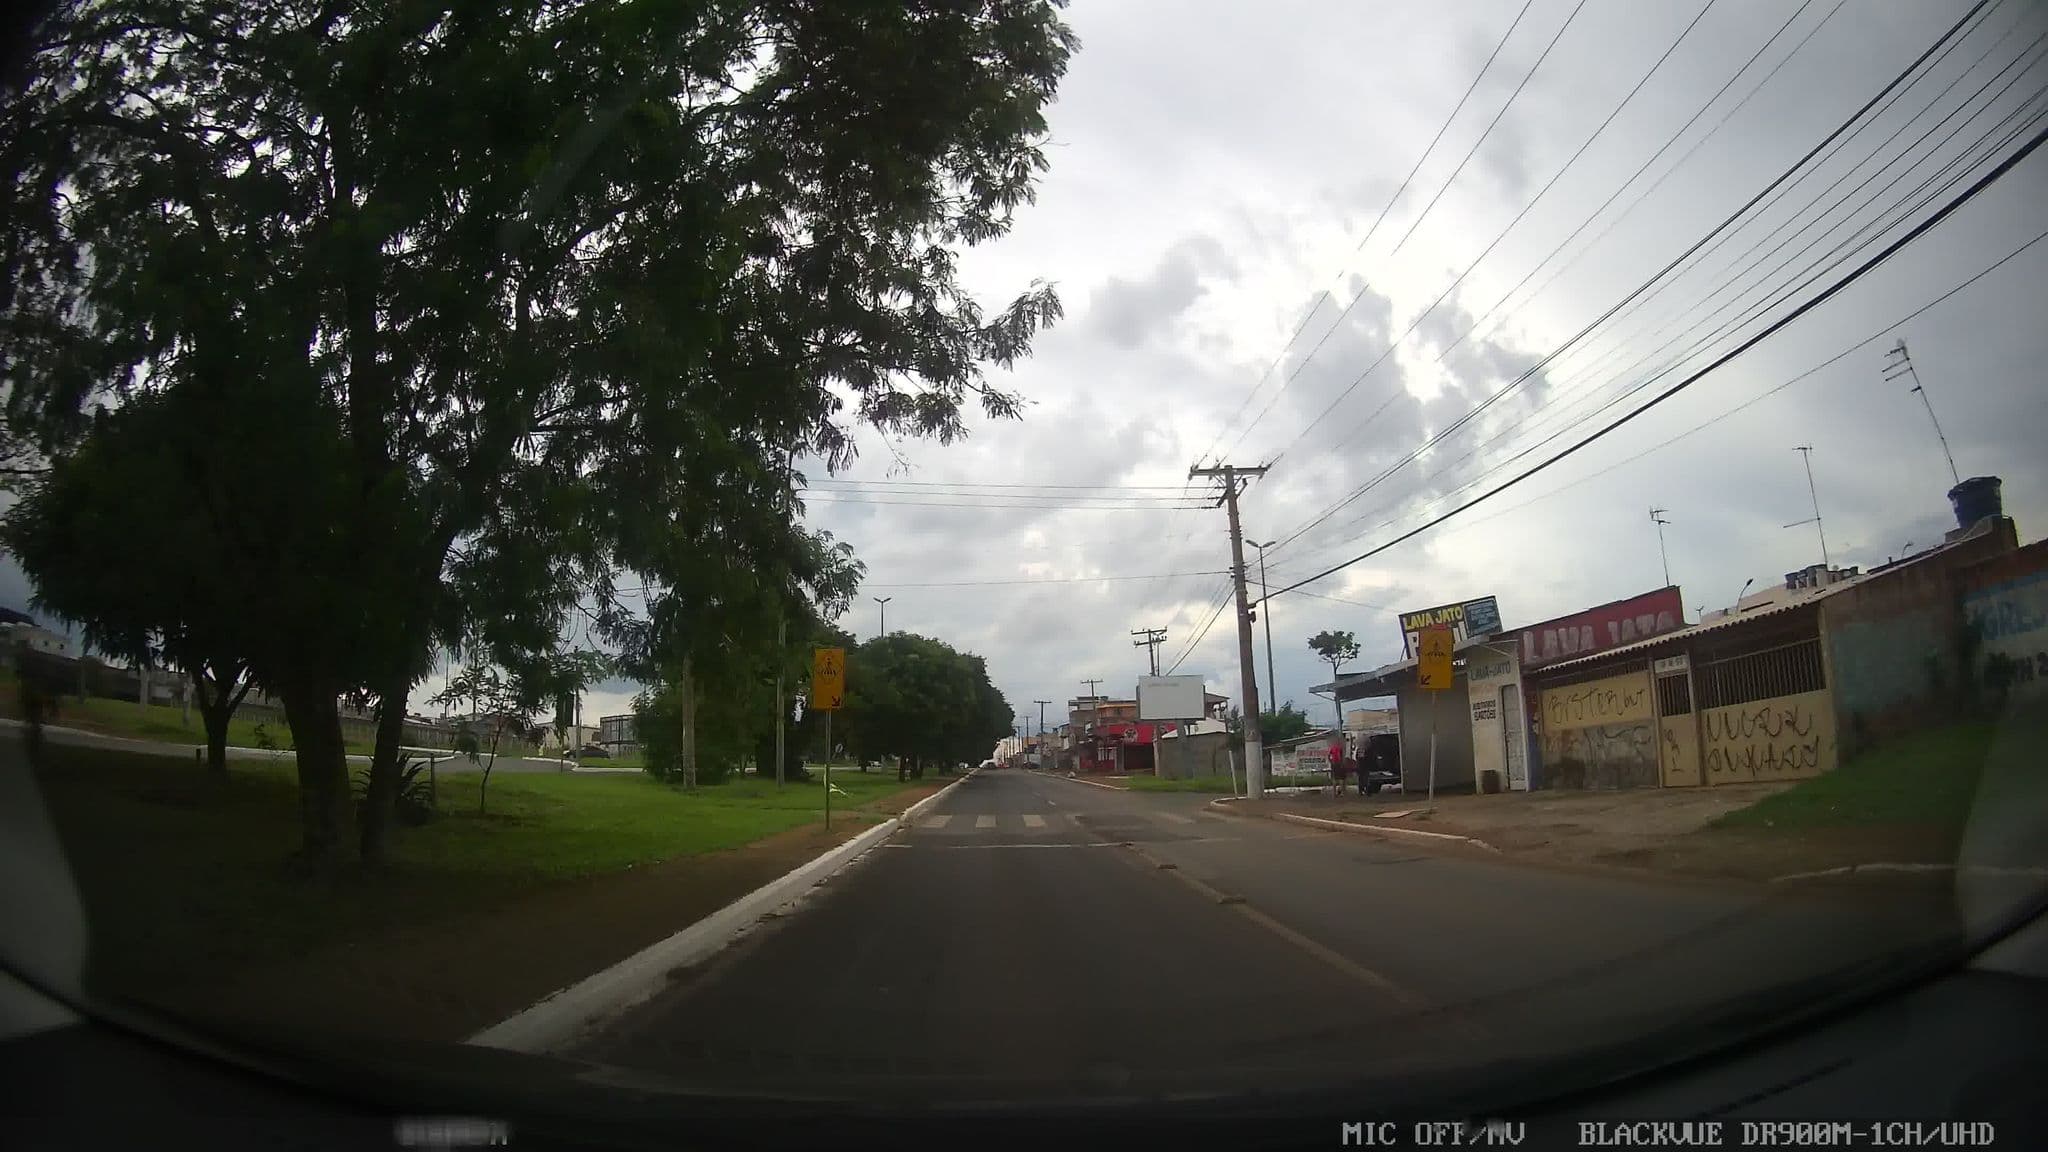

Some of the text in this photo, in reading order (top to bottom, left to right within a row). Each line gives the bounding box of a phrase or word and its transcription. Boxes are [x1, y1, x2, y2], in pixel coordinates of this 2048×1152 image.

[1403, 613, 1434, 630] LAVA
[1435, 606, 1464, 624] JATO
[1523, 610, 1675, 664] LAVA JATO
